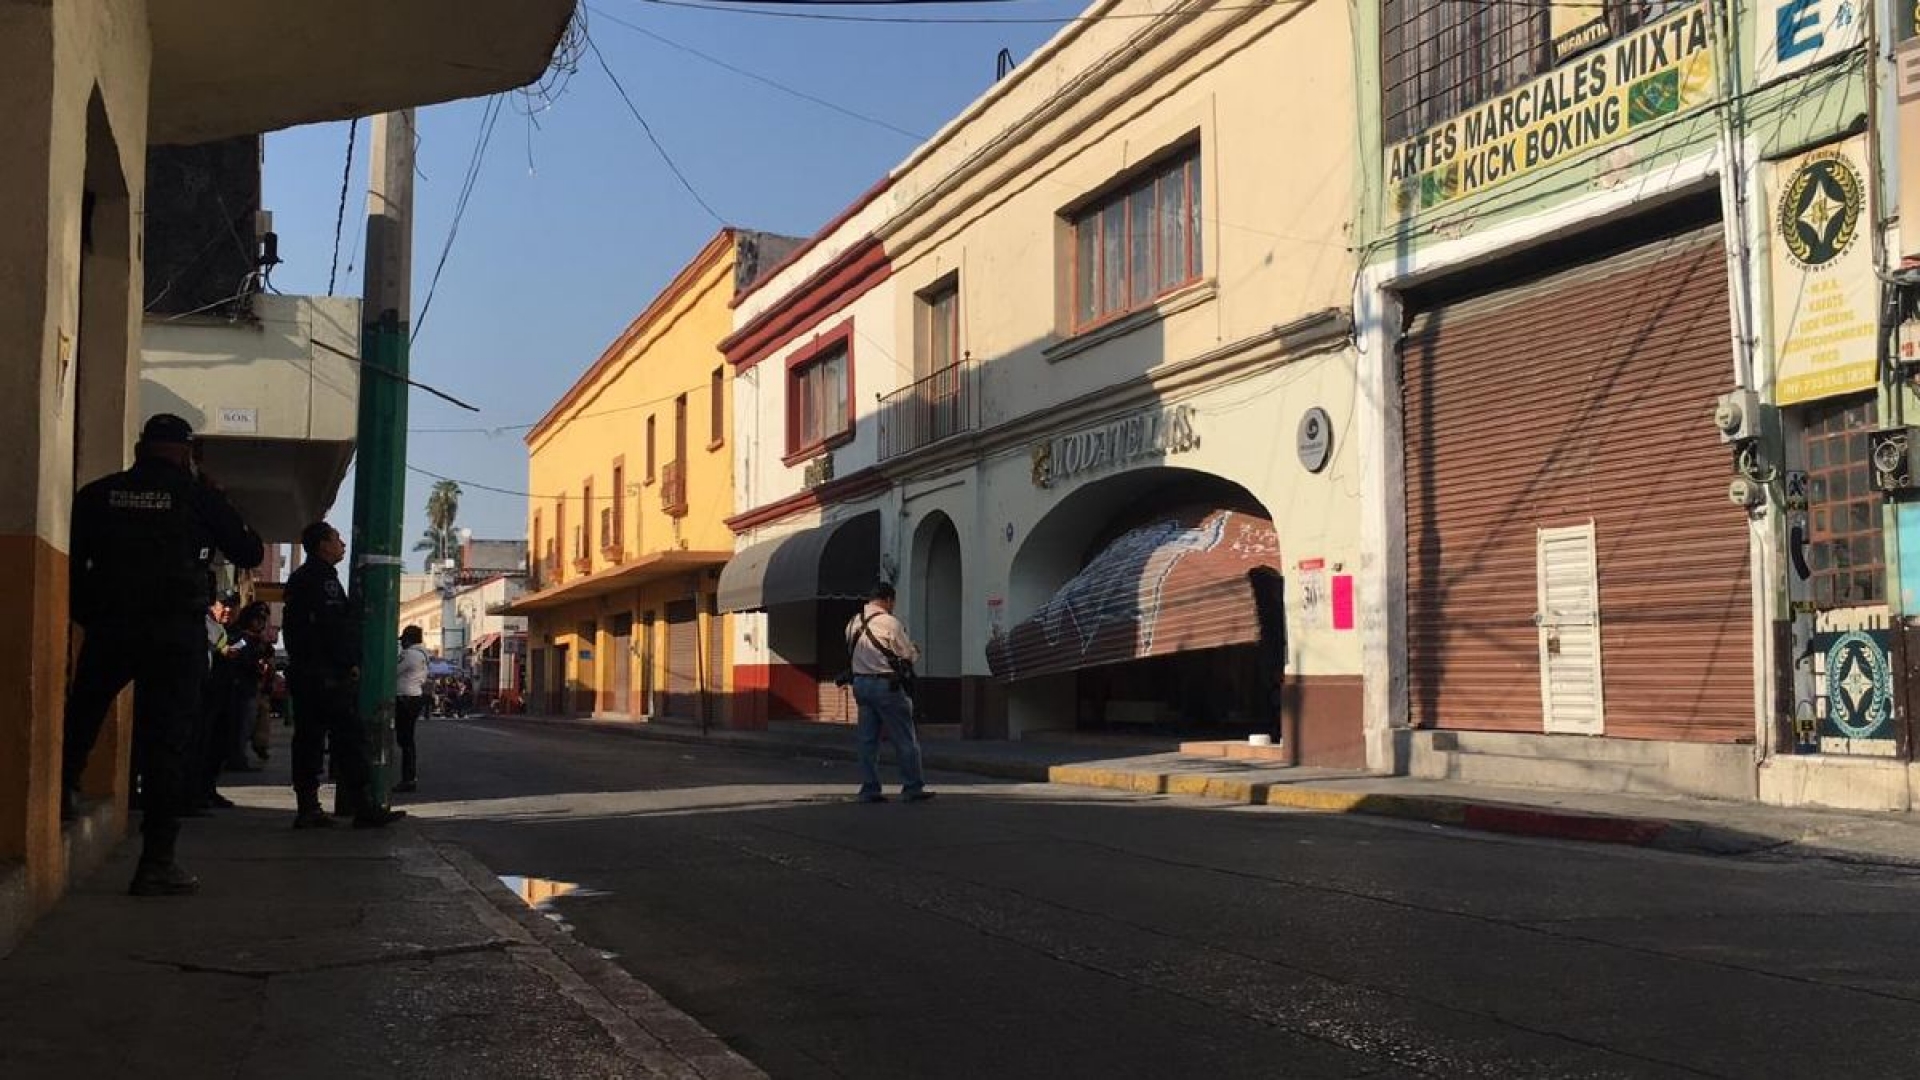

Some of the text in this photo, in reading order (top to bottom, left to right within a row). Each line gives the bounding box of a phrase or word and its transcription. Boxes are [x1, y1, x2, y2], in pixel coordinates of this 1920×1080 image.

[1389, 9, 1716, 185] ARTES MARCIALES MIXTA
[1463, 95, 1621, 193] KICK BOXING
